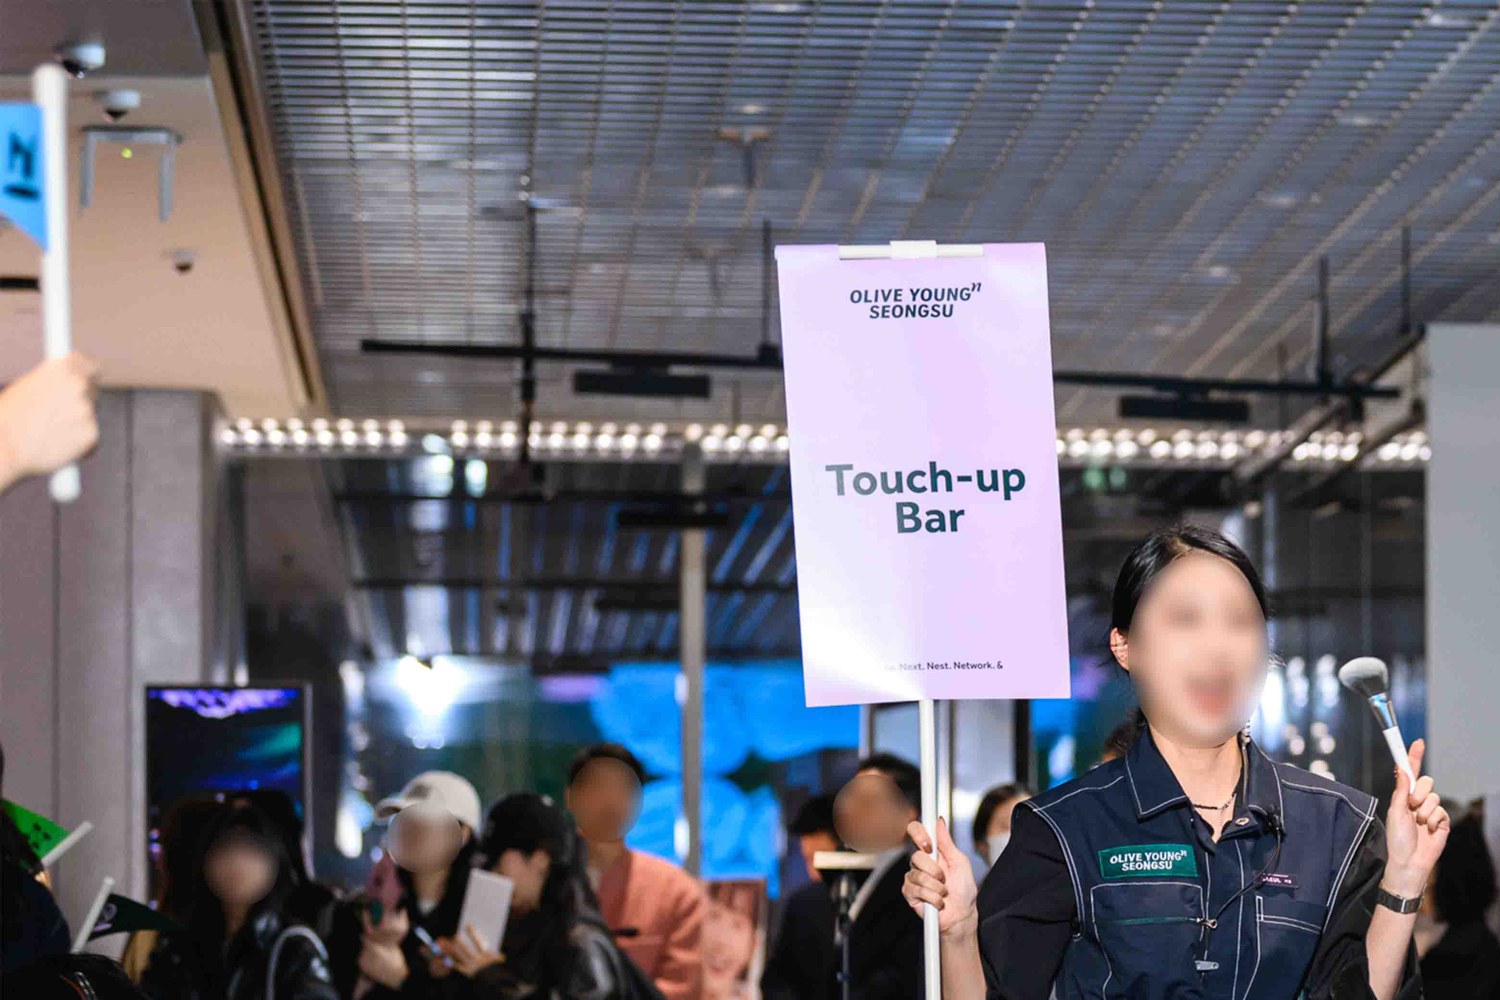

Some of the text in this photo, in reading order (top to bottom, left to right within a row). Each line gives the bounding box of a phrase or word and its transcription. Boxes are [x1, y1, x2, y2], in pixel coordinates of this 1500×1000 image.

[850, 288, 903, 304] OLIVE
[869, 304, 954, 319] SEONGSU
[825, 461, 1026, 501] Touch-up
[895, 501, 966, 534] Bar
[926, 661, 952, 670] Nest.
[953, 660, 996, 670] Network.
[996, 660, 1003, 669] &
[1109, 853, 1143, 864] OLIVE
[1121, 861, 1173, 871] SEONGSU
